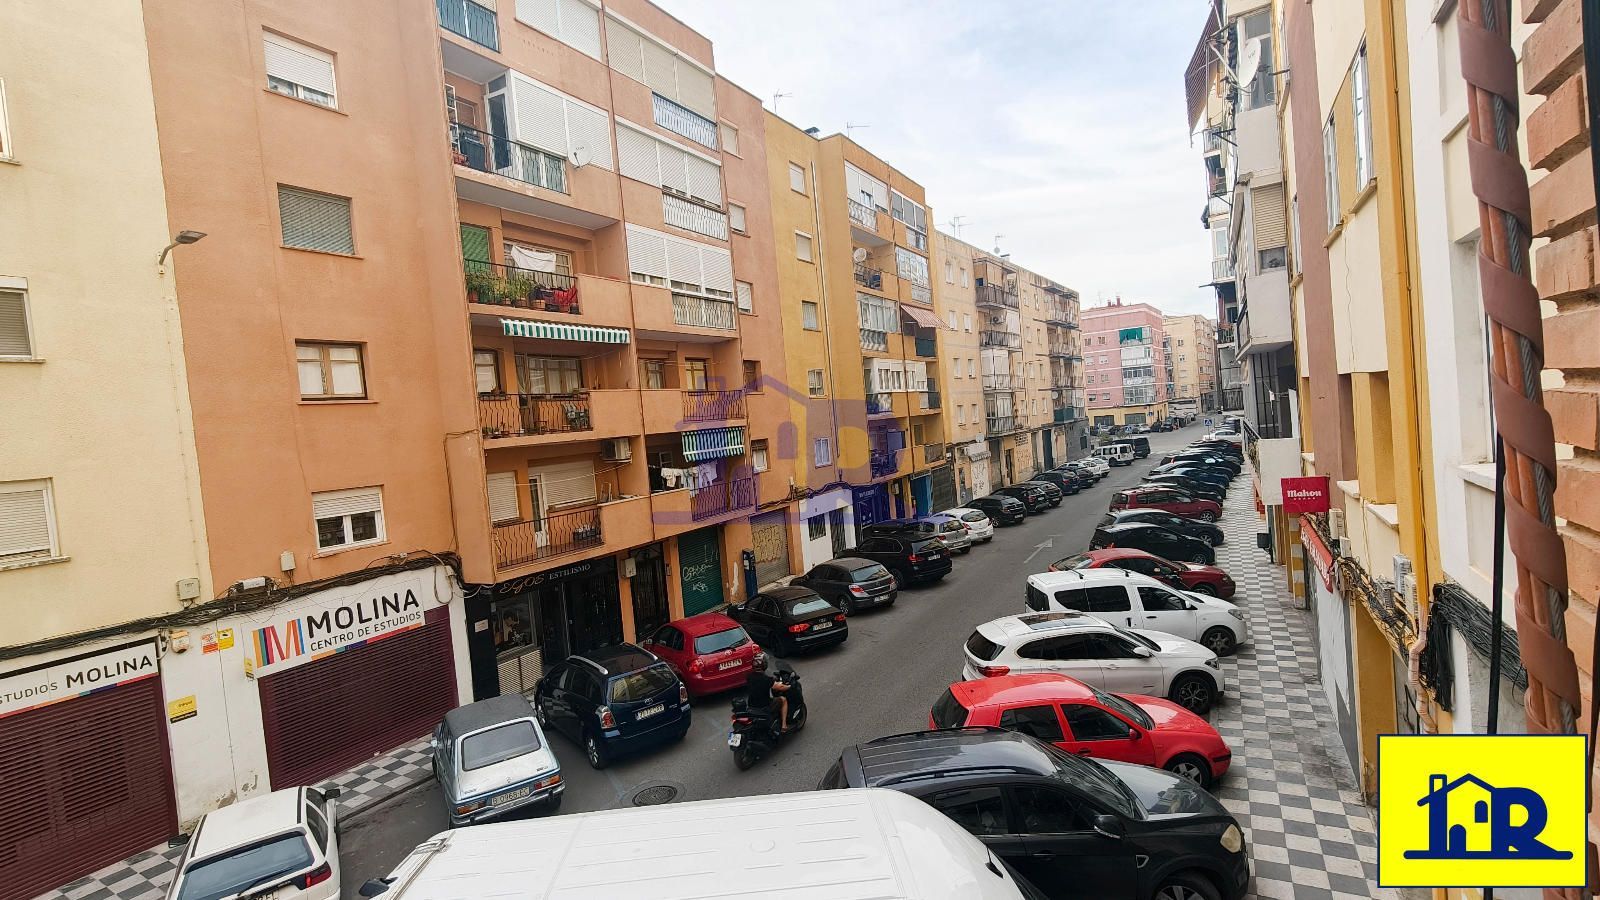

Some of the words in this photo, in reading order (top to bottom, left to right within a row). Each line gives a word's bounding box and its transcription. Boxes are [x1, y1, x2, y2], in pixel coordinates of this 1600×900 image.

[549, 564, 591, 580] ESTILISMO
[306, 588, 420, 639] MOLINA
[310, 632, 354, 652] CENTRO
[358, 626, 371, 638] DE
[374, 611, 422, 632] ESTUDIOS
[66, 655, 153, 688] MOLINA
